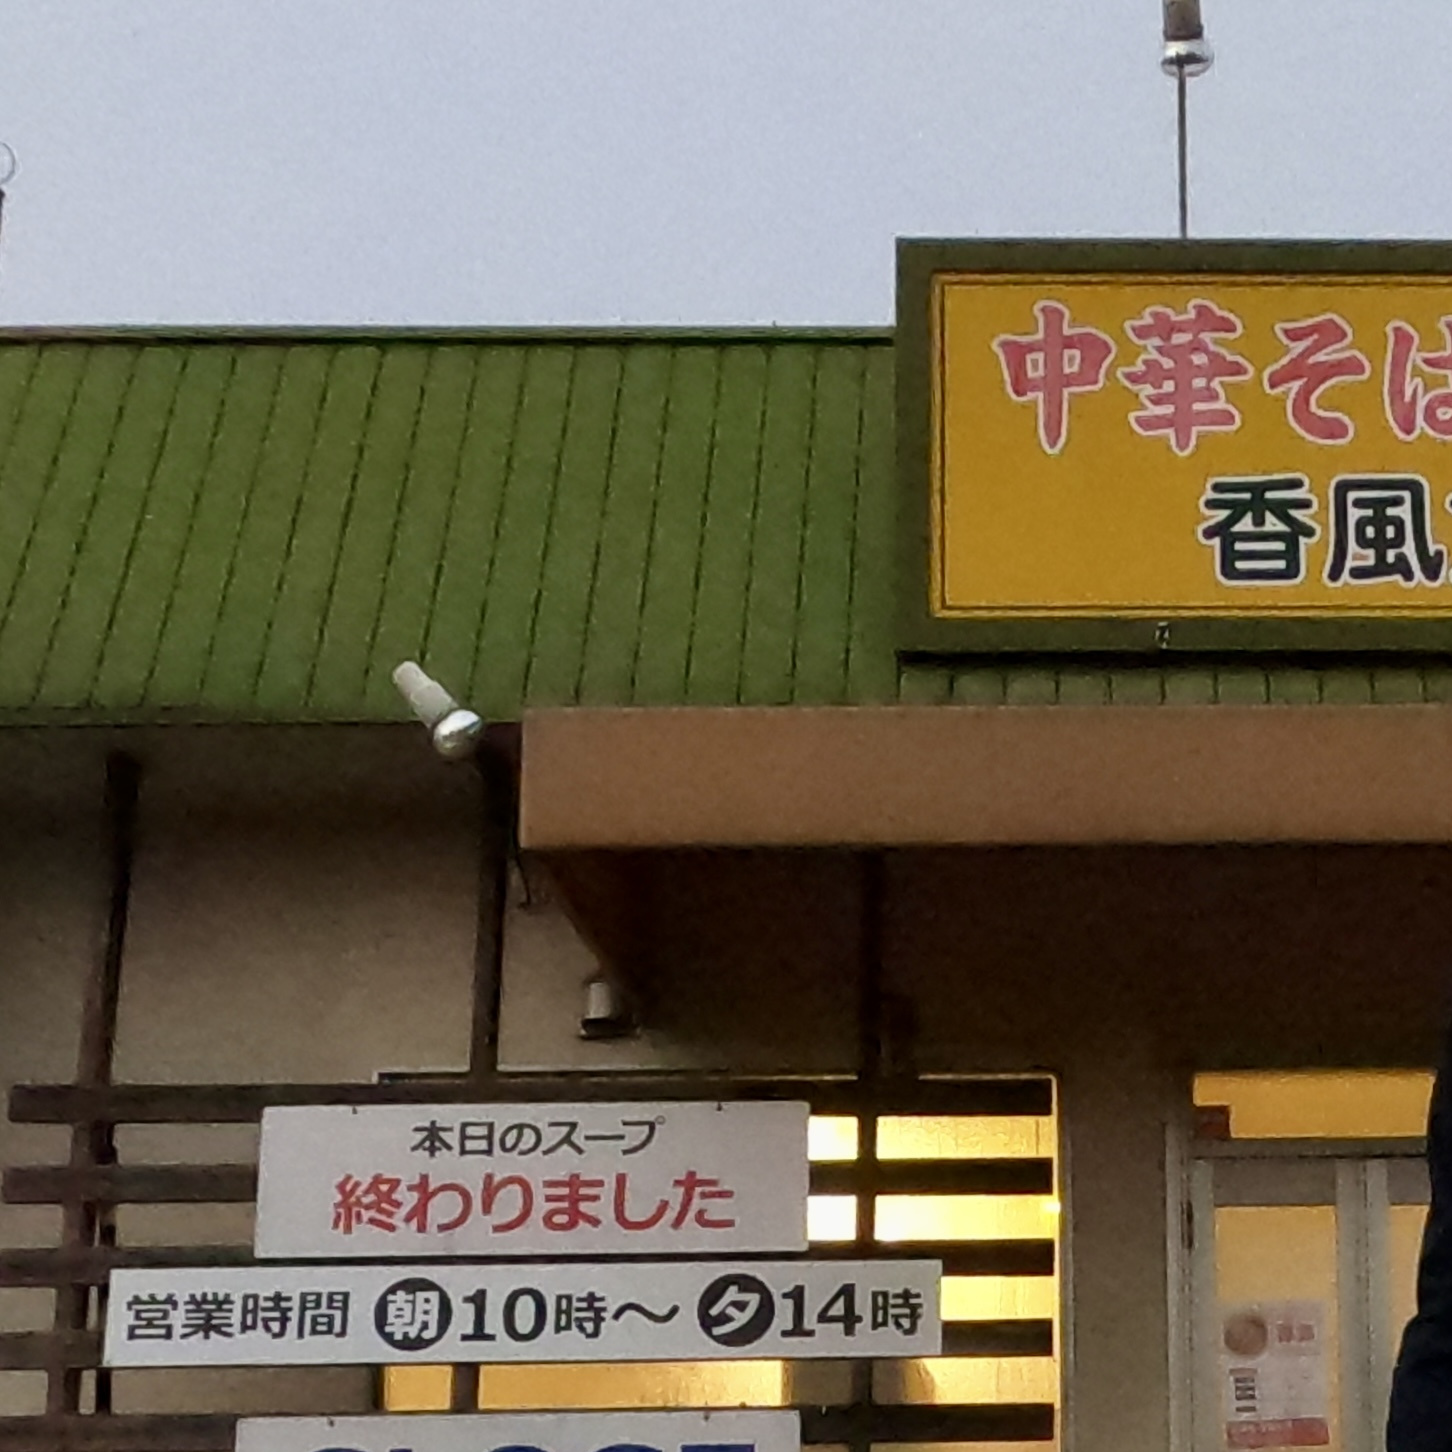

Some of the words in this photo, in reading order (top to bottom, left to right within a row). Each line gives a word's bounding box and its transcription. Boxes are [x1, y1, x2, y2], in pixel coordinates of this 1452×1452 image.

[411, 1116, 666, 1158] 本日のスープ
[331, 1170, 735, 1236] 終わりました
[126, 1292, 350, 1341] 営業時間
